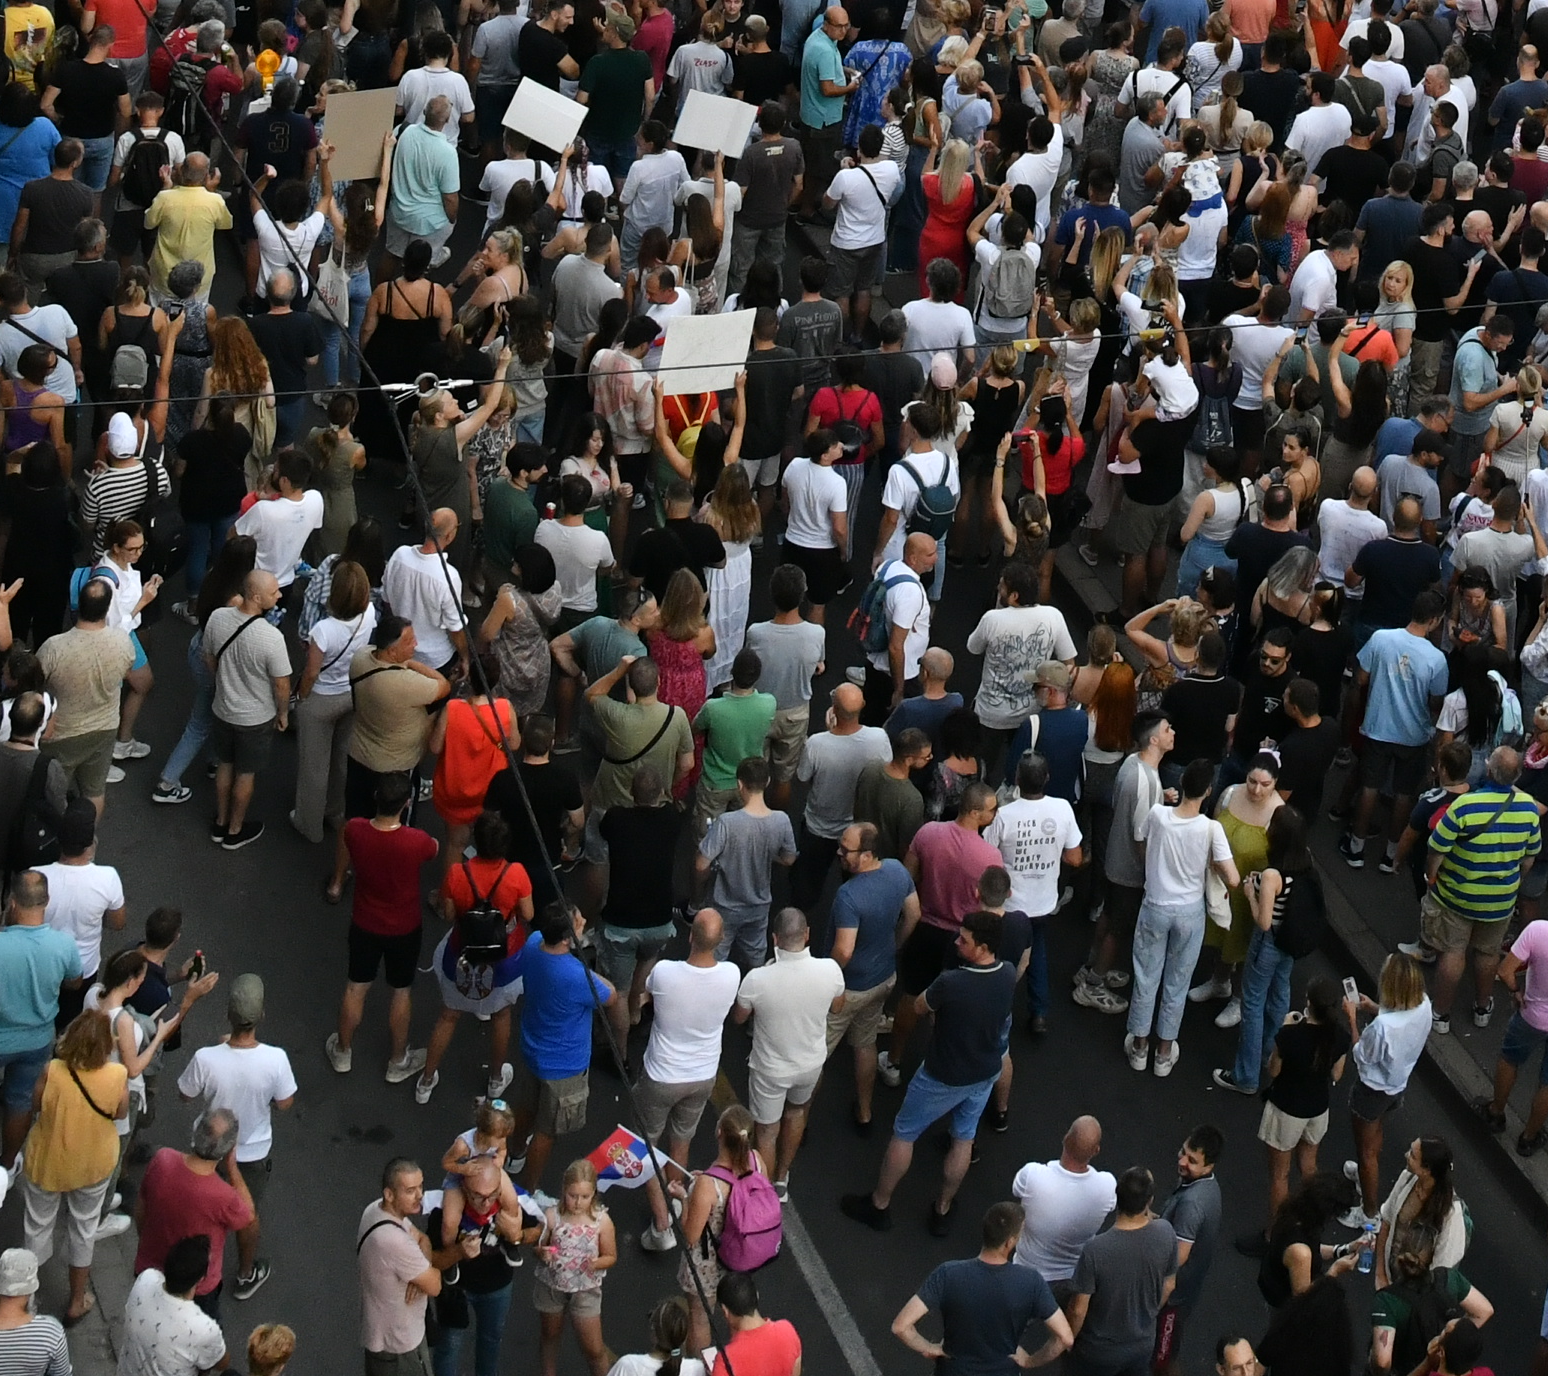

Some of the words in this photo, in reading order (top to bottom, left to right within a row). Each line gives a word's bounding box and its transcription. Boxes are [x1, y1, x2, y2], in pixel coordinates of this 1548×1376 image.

[268, 120, 290, 153] 3
[794, 315, 813, 326] PINK
[814, 311, 840, 322] FLOYD
[1016, 837, 1056, 846] WEEKEND
[1015, 848, 1027, 856] WE
[1014, 854, 1041, 864] PARTY
